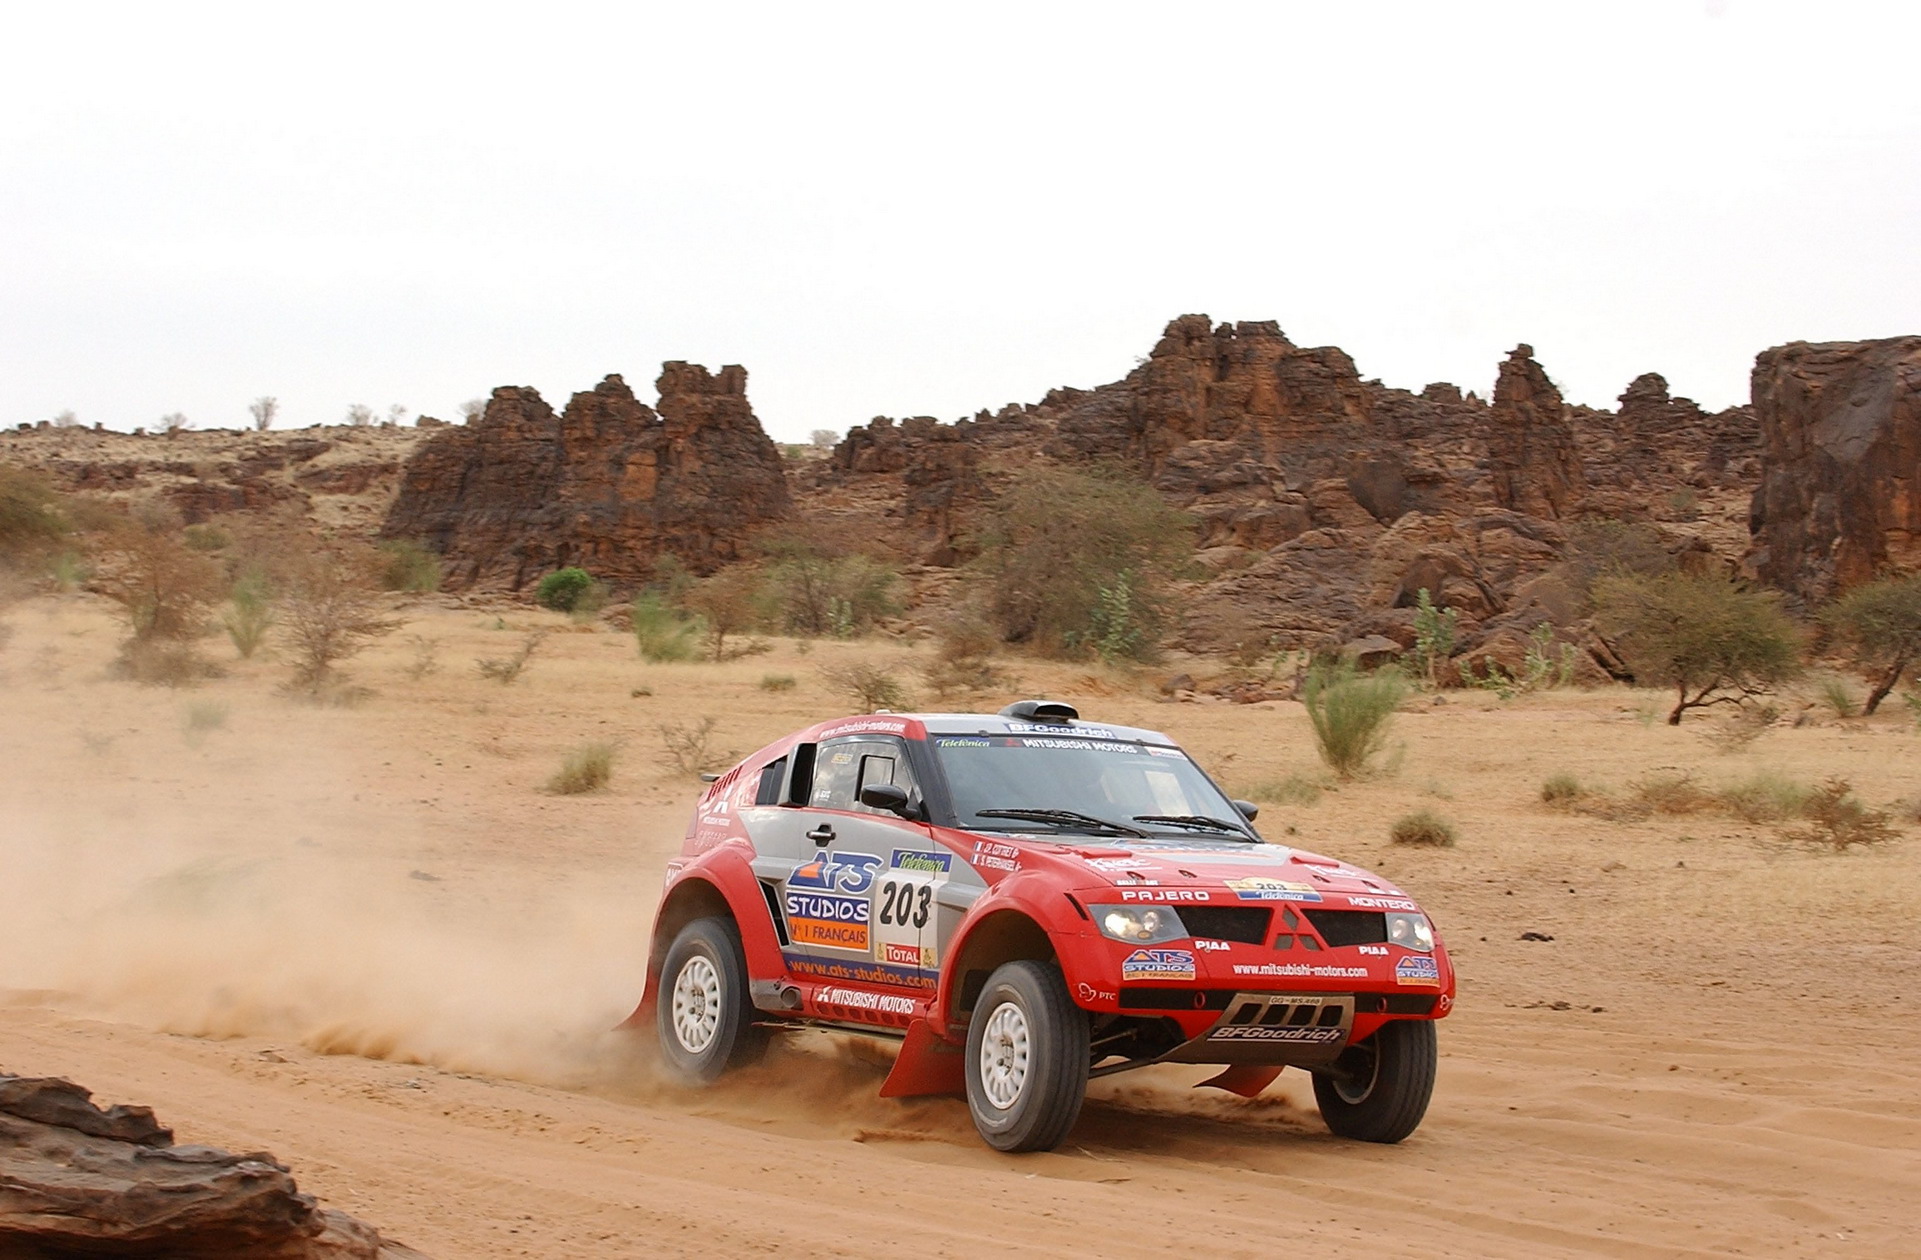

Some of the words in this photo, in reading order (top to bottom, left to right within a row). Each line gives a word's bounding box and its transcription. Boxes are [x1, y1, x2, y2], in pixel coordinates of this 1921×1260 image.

[1008, 723, 1114, 739] BFGoodrich
[1022, 739, 1092, 751] MITSUBISHI
[1091, 742, 1138, 754] MOTORS
[787, 850, 884, 894] ATS
[1122, 891, 1210, 901] PAJERO
[787, 895, 869, 922] STUDIOS
[879, 880, 932, 929] 203
[1348, 897, 1415, 911] MONTERO
[1195, 940, 1230, 951] PIAA
[1359, 946, 1389, 955] PIAA
[1123, 949, 1195, 965] ATS
[789, 960, 936, 989] www.ats-studios.com
[1124, 964, 1194, 972] STUDIOS
[1233, 963, 1368, 977] www.mitsubishi-motors.com
[831, 989, 879, 1009] MITSUBISHI
[878, 993, 916, 1014] MOTORS
[1099, 991, 1116, 1000] PTC
[1212, 1027, 1341, 1041] BFGoodrich
